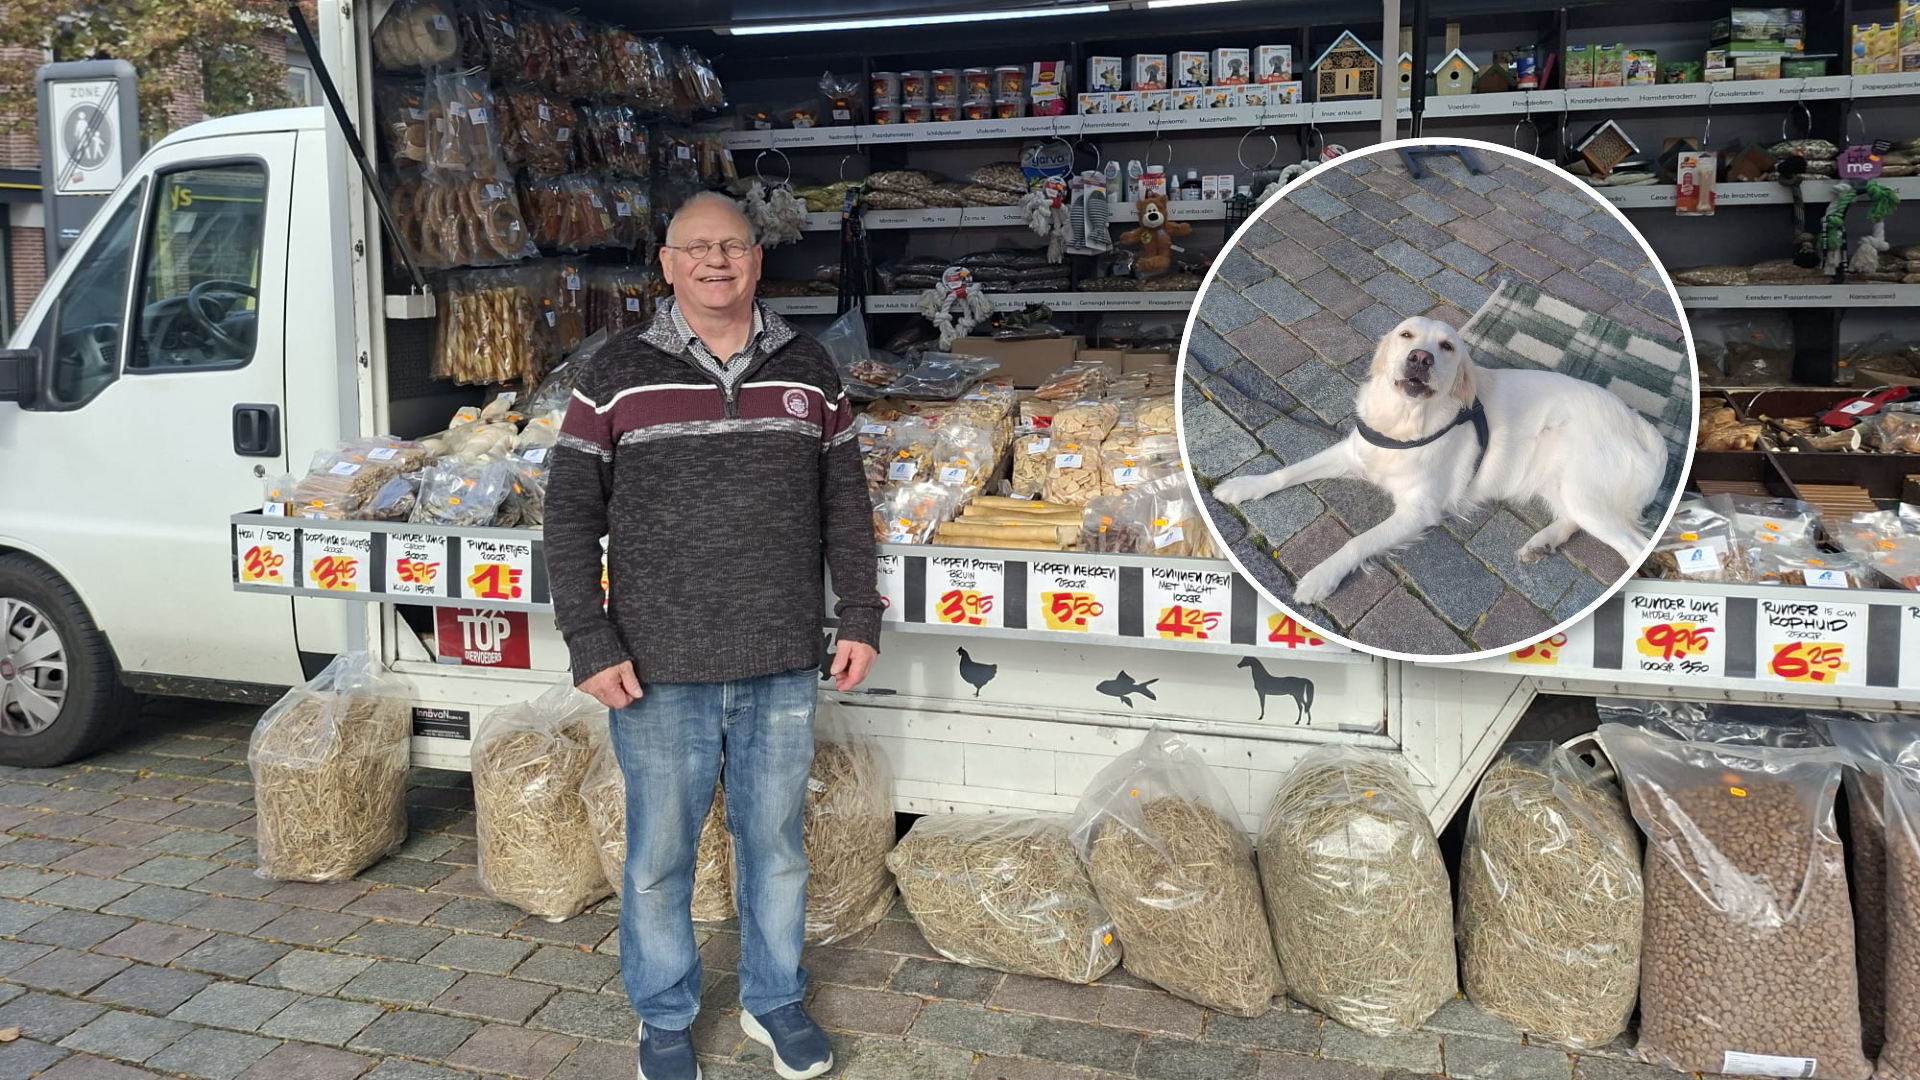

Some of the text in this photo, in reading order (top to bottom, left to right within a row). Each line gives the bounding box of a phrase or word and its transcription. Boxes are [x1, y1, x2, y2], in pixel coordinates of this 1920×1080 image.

[71, 87, 100, 97] ZONE
[1847, 162, 1873, 173] me
[267, 531, 291, 542] STRO
[467, 539, 496, 552] PINDA
[932, 556, 1003, 575] KIPPEN POTEN
[1033, 561, 1070, 575] KIPPEN
[946, 569, 976, 580] BRUIN
[1205, 573, 1231, 589] OPEN
[1158, 581, 1217, 595] MET VACHT
[941, 589, 994, 626] 3.95
[1051, 592, 1104, 626] 5.50
[1631, 595, 1685, 610] RUNDER
[1762, 601, 1819, 617] RUNDER
[1825, 607, 1833, 616] 15
[1156, 604, 1222, 639] 4.25
[1641, 611, 1673, 621] MIDDEL
[1769, 614, 1848, 632] KOPHUID
[457, 615, 511, 652] TOP
[1646, 623, 1716, 662] 9.95
[464, 650, 503, 664] DIERVOEDERS
[1772, 641, 1843, 681] 6.25
[1679, 659, 1709, 674] 350
